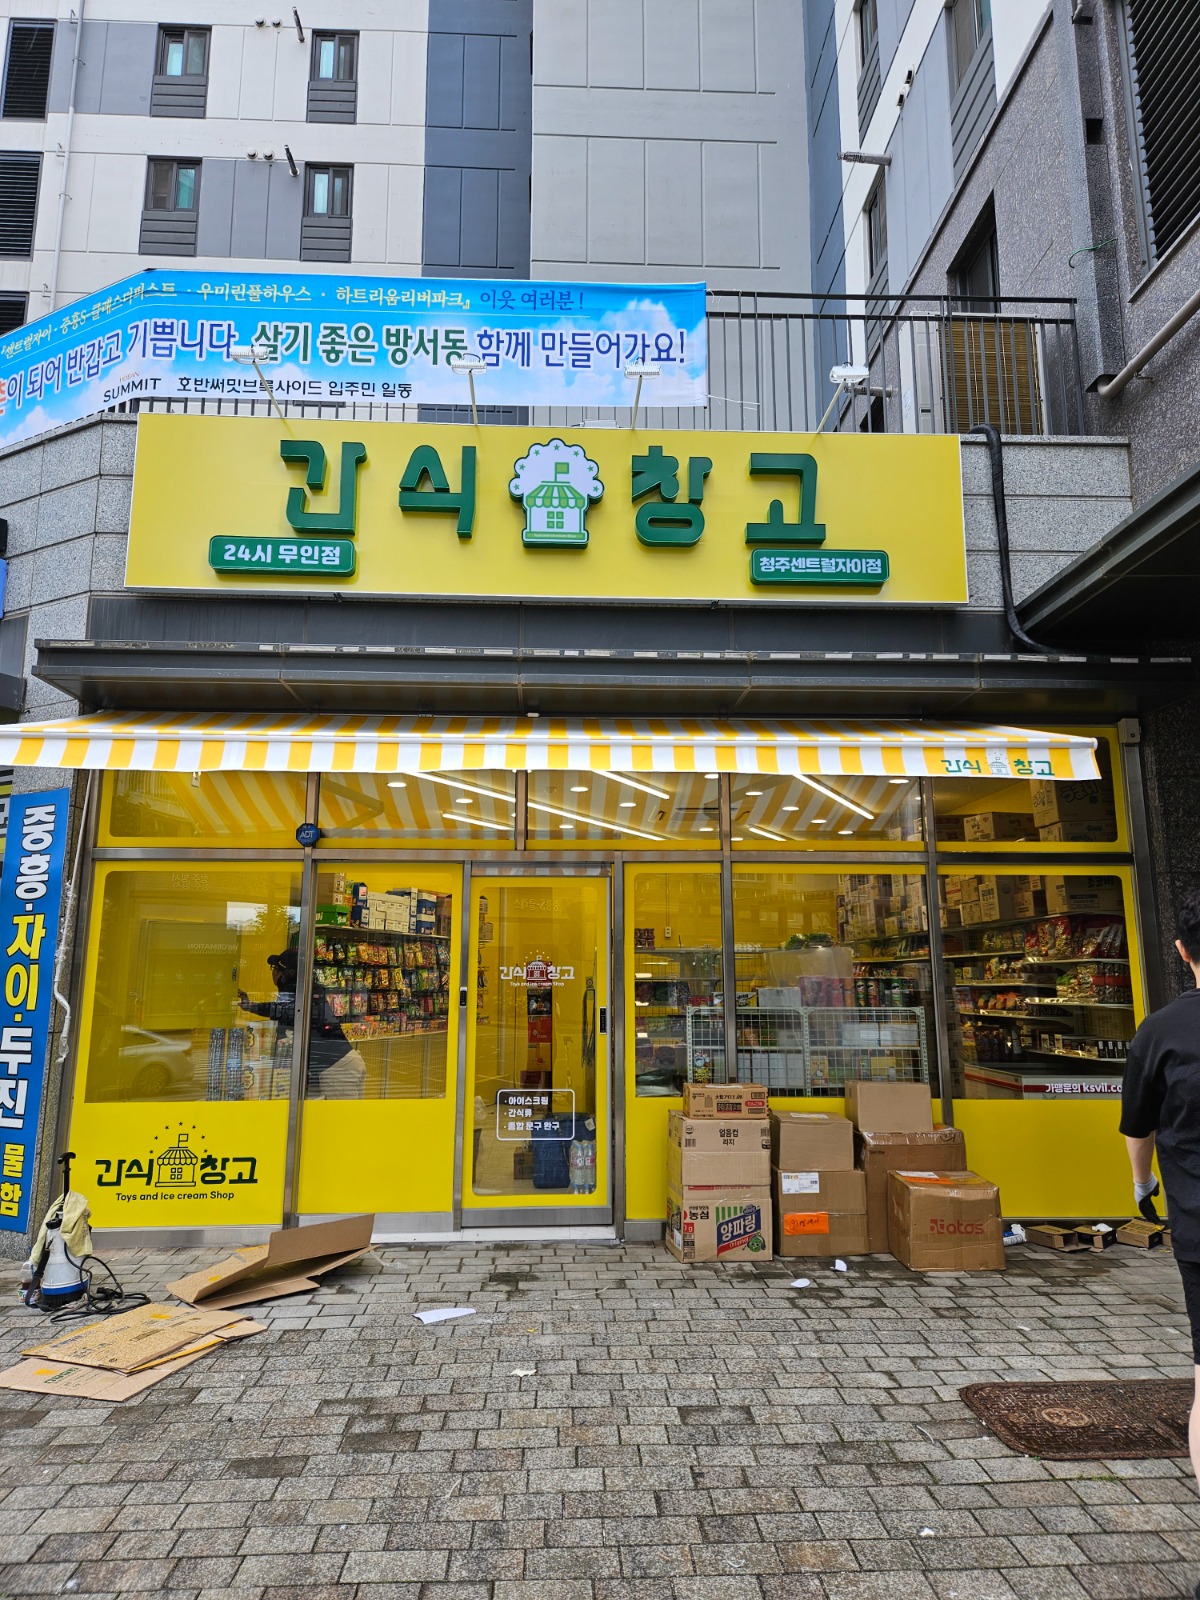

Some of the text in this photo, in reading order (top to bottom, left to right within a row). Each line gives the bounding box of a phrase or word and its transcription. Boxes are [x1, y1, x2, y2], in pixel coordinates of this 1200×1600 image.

[196, 282, 312, 303] 우미린풀하우스
[480, 289, 516, 310] 이웃
[520, 289, 584, 311] 여러분!
[27, 356, 62, 398] 되어
[67, 332, 121, 385] 반갑고
[254, 324, 310, 362] 살기
[319, 324, 376, 363] 좋은
[385, 325, 468, 366] 방서동
[476, 329, 531, 367] 함께
[540, 330, 686, 369] 만들어가요!
[103, 377, 161, 403] SUMMIT
[328, 381, 376, 398] 입주민
[381, 383, 413, 399] 일동
[280, 439, 826, 548] 간식 창고
[223, 543, 341, 566] 24시 무인점
[759, 556, 882, 575] 청주센트럴자이점
[941, 758, 1055, 776] 간식 창고
[300, 830, 315, 839] ADT
[500, 966, 575, 980] 간식 창고
[1083, 1083, 1122, 1093] ksvil.co
[508, 1096, 549, 1106] 아이스크림
[718, 1128, 739, 1138] 얼음컵
[722, 1138, 735, 1146] 라지
[96, 1154, 258, 1186] 간식 창고
[116, 1193, 137, 1202] Toys
[139, 1192, 158, 1200] and
[177, 1192, 208, 1200] cream
[210, 1191, 235, 1201] Shop
[689, 1210, 710, 1220] 농심
[720, 1214, 756, 1241] 양파링
